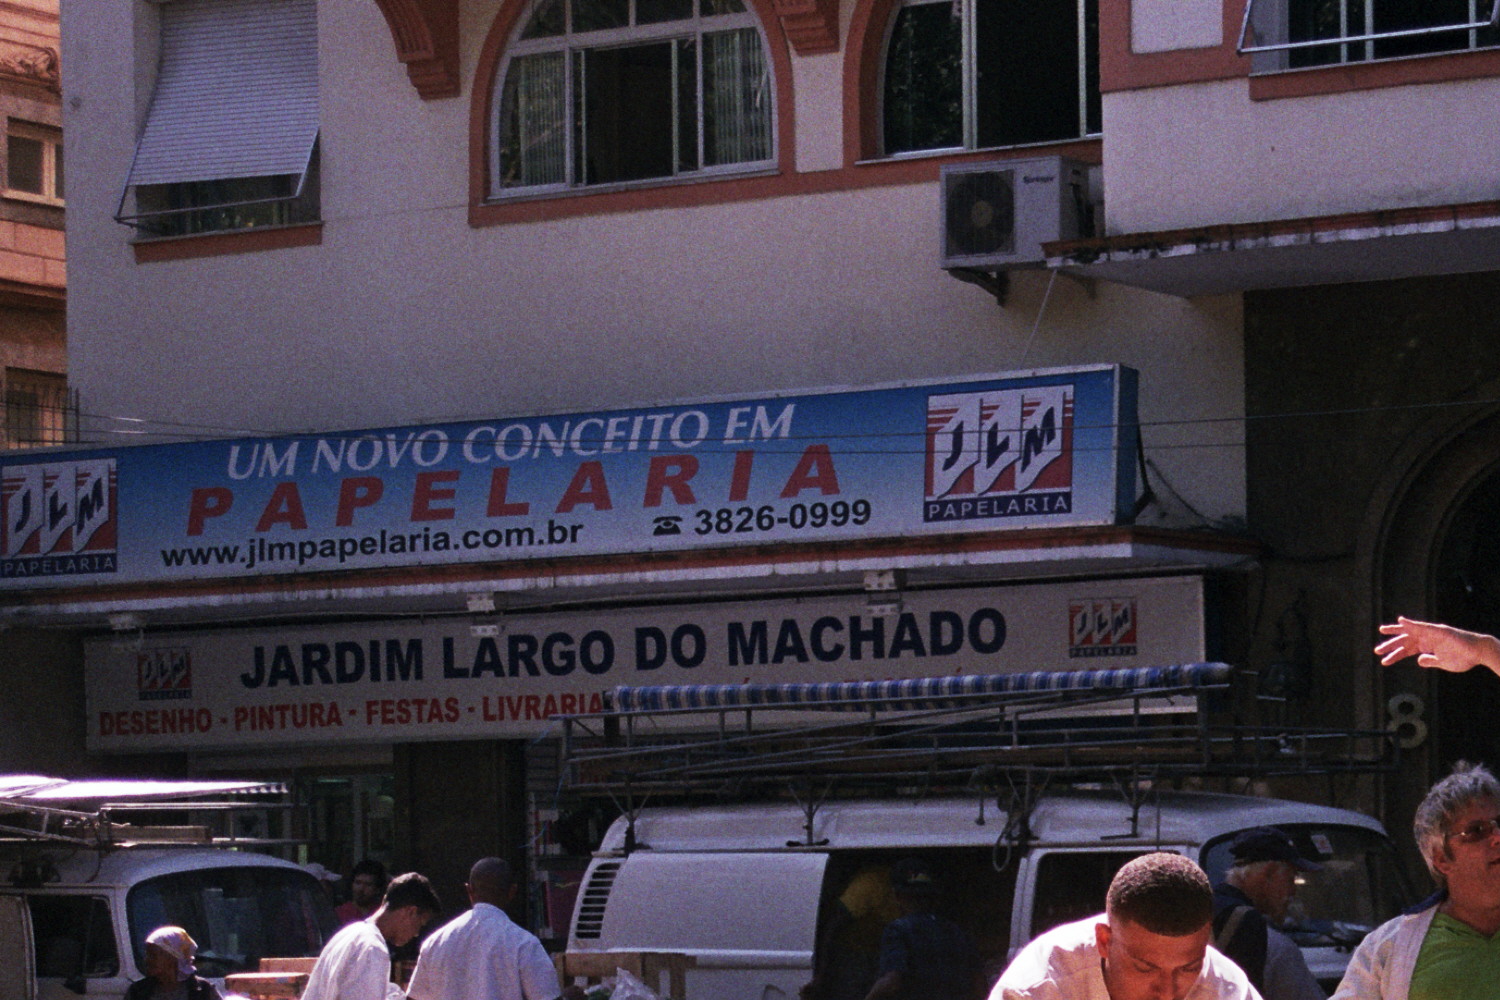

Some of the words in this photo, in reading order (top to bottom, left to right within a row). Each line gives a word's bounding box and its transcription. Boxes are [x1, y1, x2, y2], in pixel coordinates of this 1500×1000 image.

[227, 442, 298, 481] UM
[312, 428, 449, 475] NOVO
[463, 409, 710, 464] CONCEITO
[723, 403, 796, 443] EM
[186, 444, 841, 536] PAPELARIA
[929, 495, 1069, 520] PAPELARIA
[694, 499, 872, 536] 3826-0999
[3, 555, 115, 575] PAPELARIA
[161, 520, 585, 570] www.jlmpapelaria.com.br
[241, 638, 424, 689] JARDIM
[443, 630, 615, 679] LARGO
[635, 623, 707, 671] DO
[728, 608, 1008, 666] MACHADO
[100, 708, 212, 737] DESENHO
[235, 703, 340, 731] PINTURA
[366, 698, 459, 725] FESTAS
[482, 692, 602, 720] LIVRARIA
[1386, 692, 1429, 749] 8
